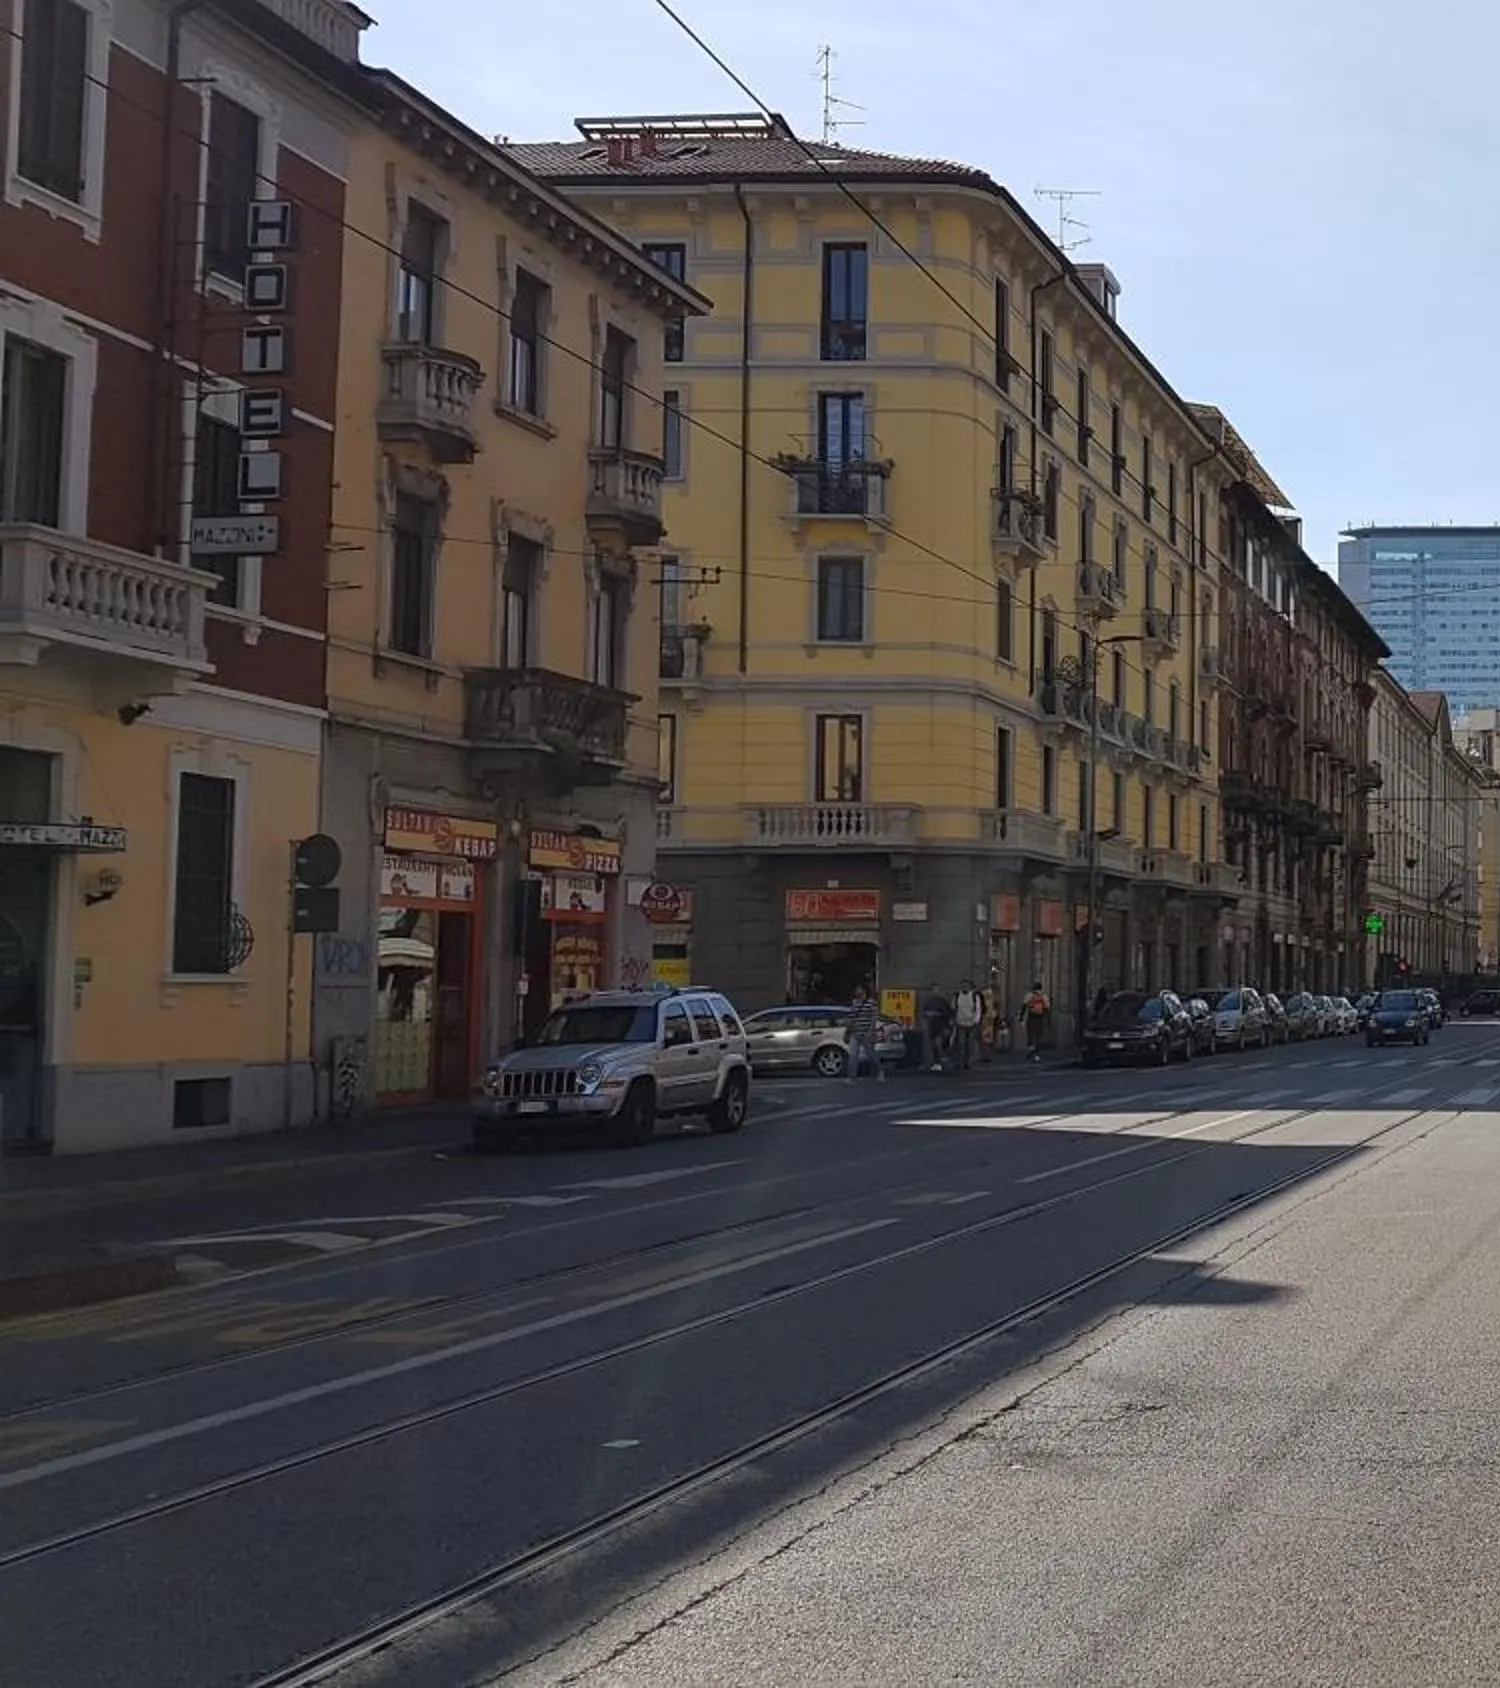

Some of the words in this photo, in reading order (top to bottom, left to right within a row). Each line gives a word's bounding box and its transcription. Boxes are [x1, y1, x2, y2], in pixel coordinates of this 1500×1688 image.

[243, 204, 289, 496] HOTEL
[2, 826, 57, 843] OTEL
[585, 853, 619, 873] PIZZA
